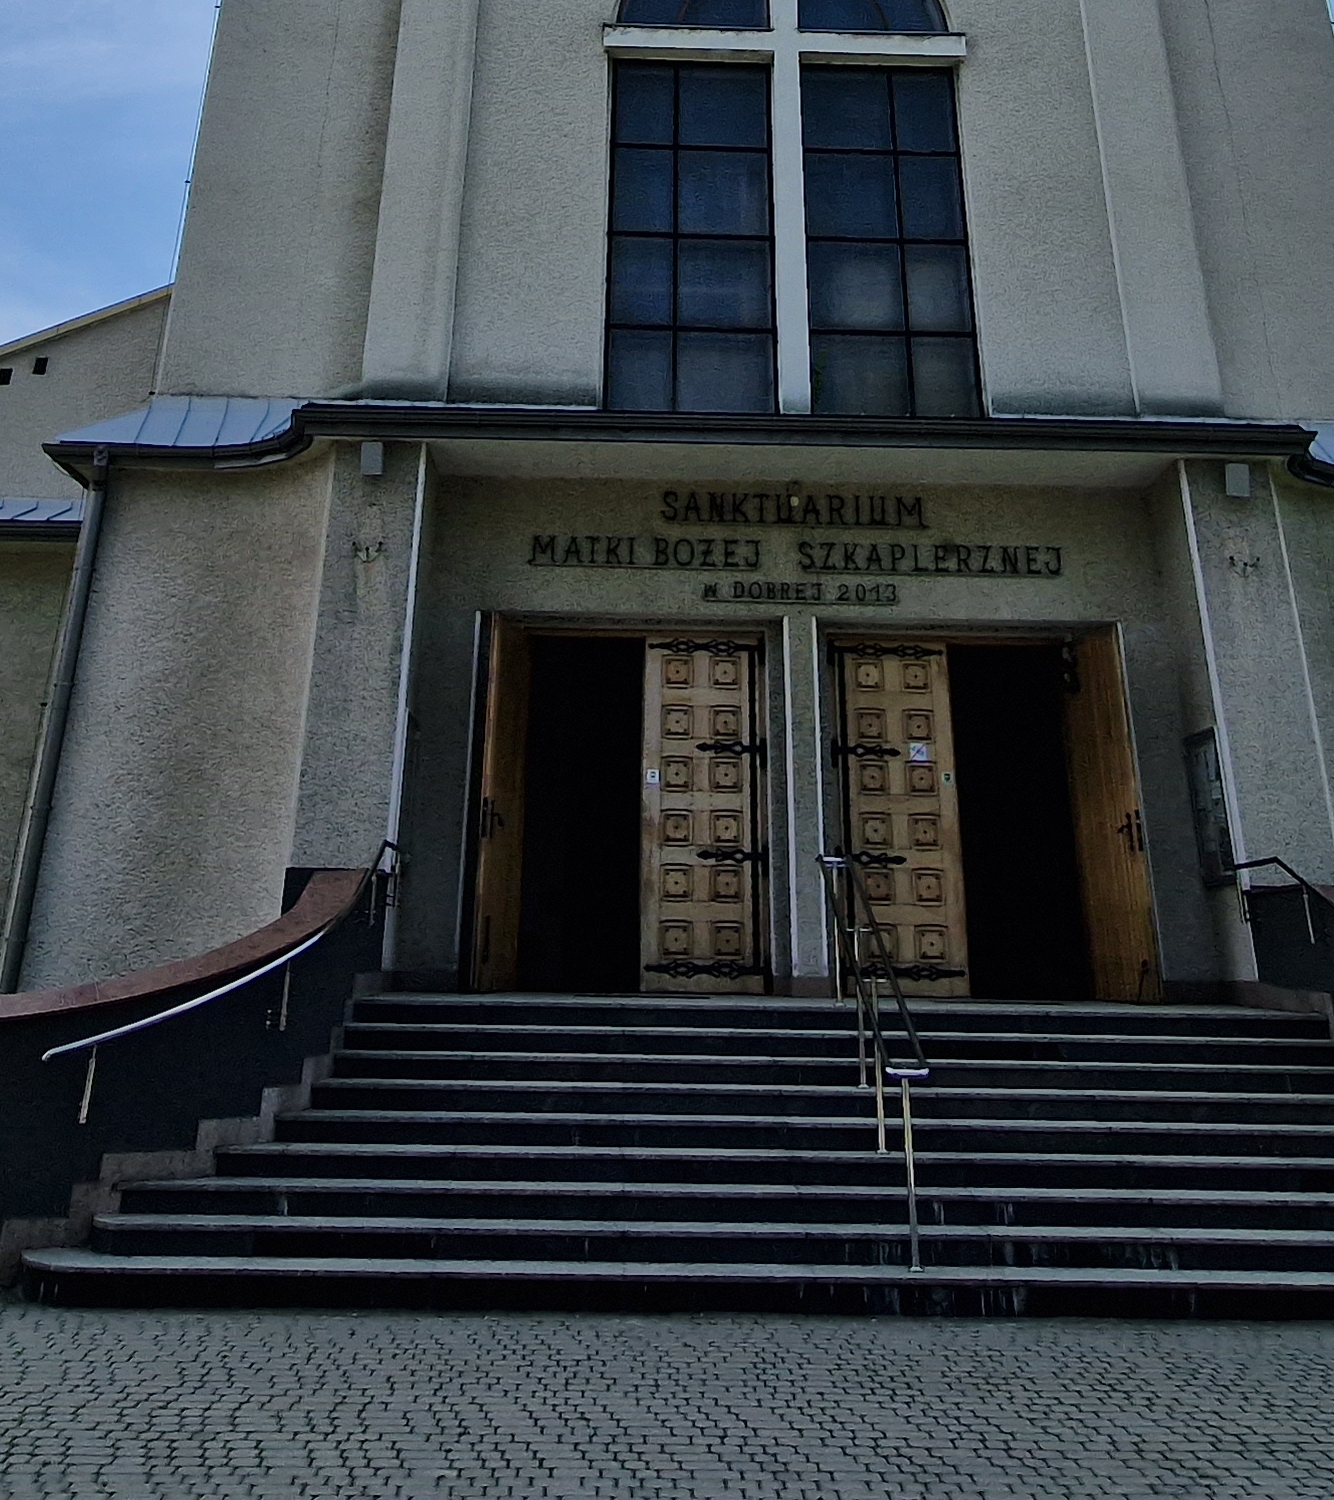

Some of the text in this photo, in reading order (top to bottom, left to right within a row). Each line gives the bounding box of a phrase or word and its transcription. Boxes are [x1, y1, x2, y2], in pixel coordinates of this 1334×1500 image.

[660, 491, 928, 528] SANKTUARIUM
[528, 535, 635, 565] MATKI
[798, 542, 1063, 574] SZKAPLERZNEJ
[733, 581, 822, 601] DOBREJ
[837, 583, 897, 602] 2013
